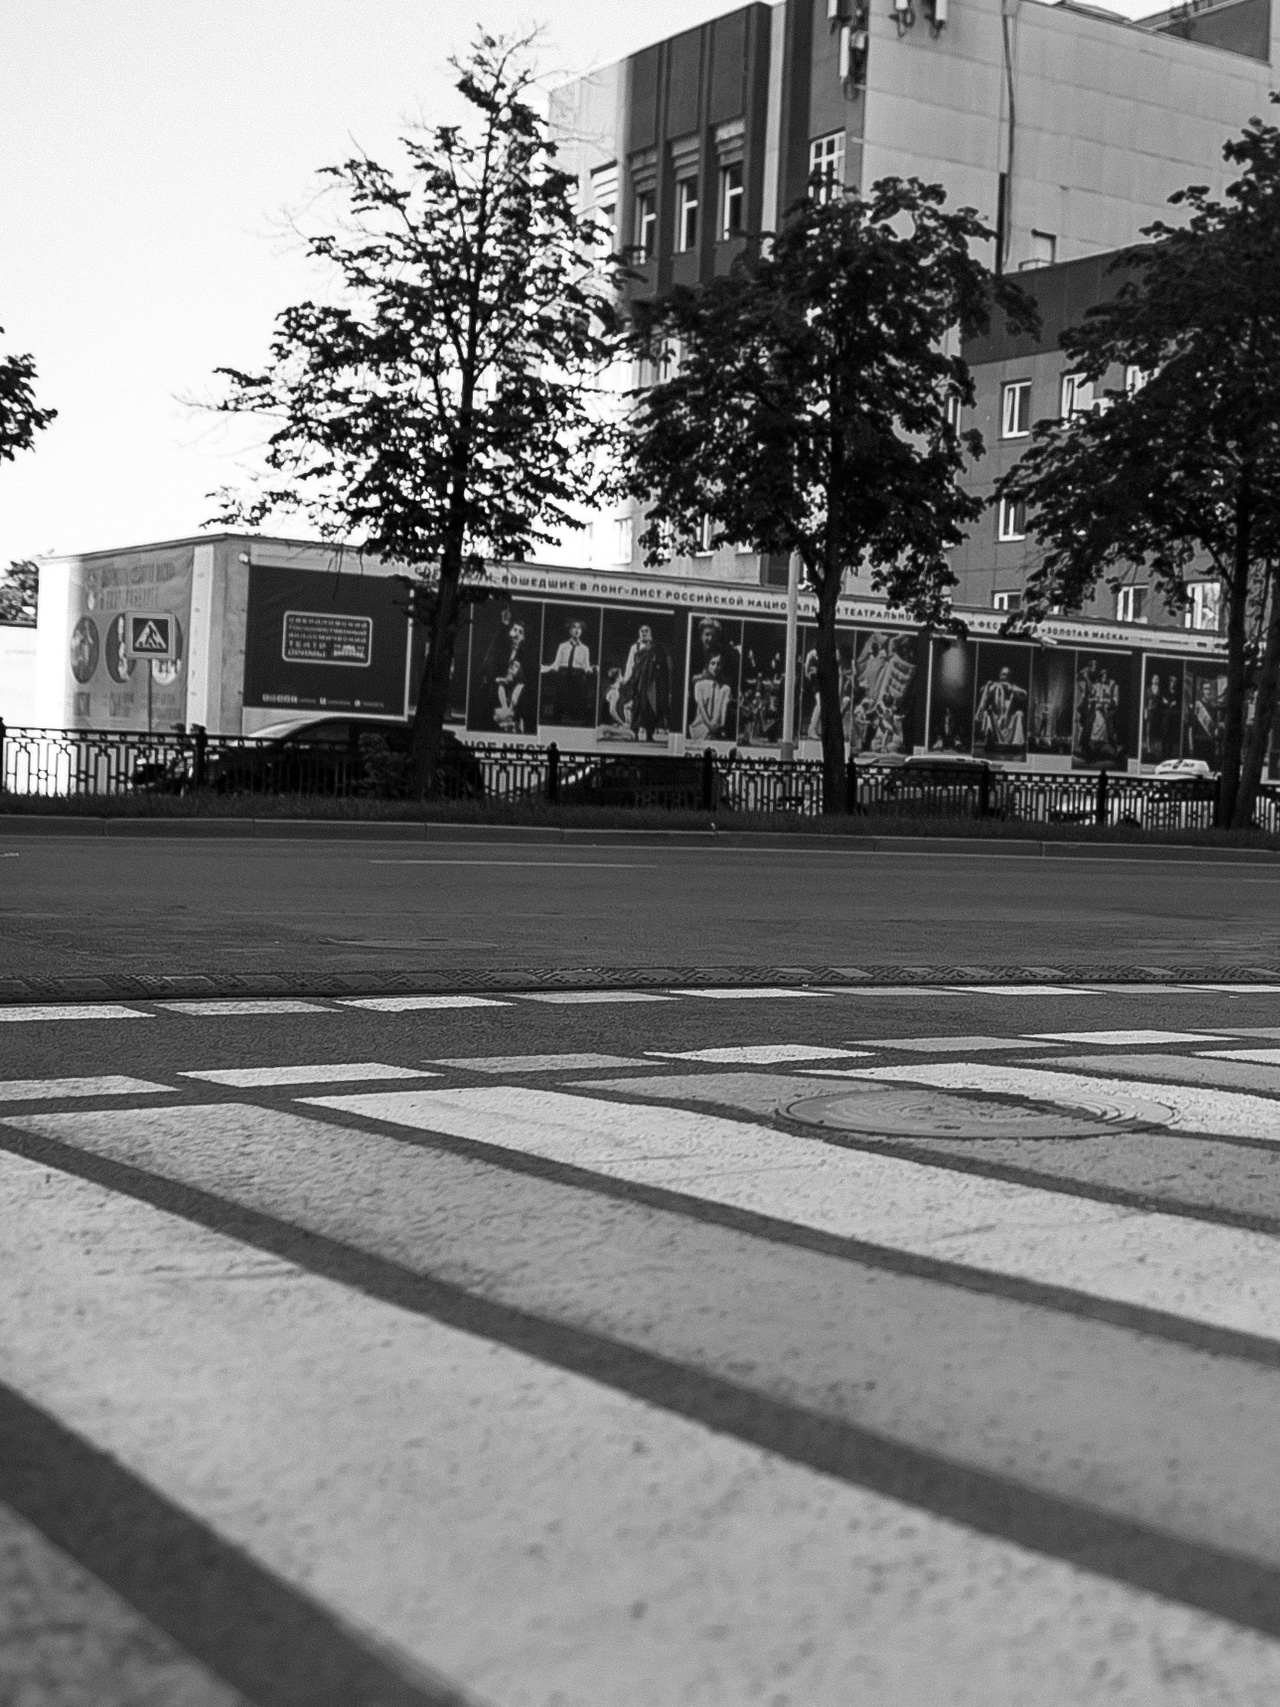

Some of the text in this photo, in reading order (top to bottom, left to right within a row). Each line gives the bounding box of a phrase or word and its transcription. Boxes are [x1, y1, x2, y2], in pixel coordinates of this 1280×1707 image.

[501, 574, 576, 591] ВОШЕДШИЕ
[579, 581, 588, 591] В
[665, 590, 744, 606] РОССИЙСКОЙ
